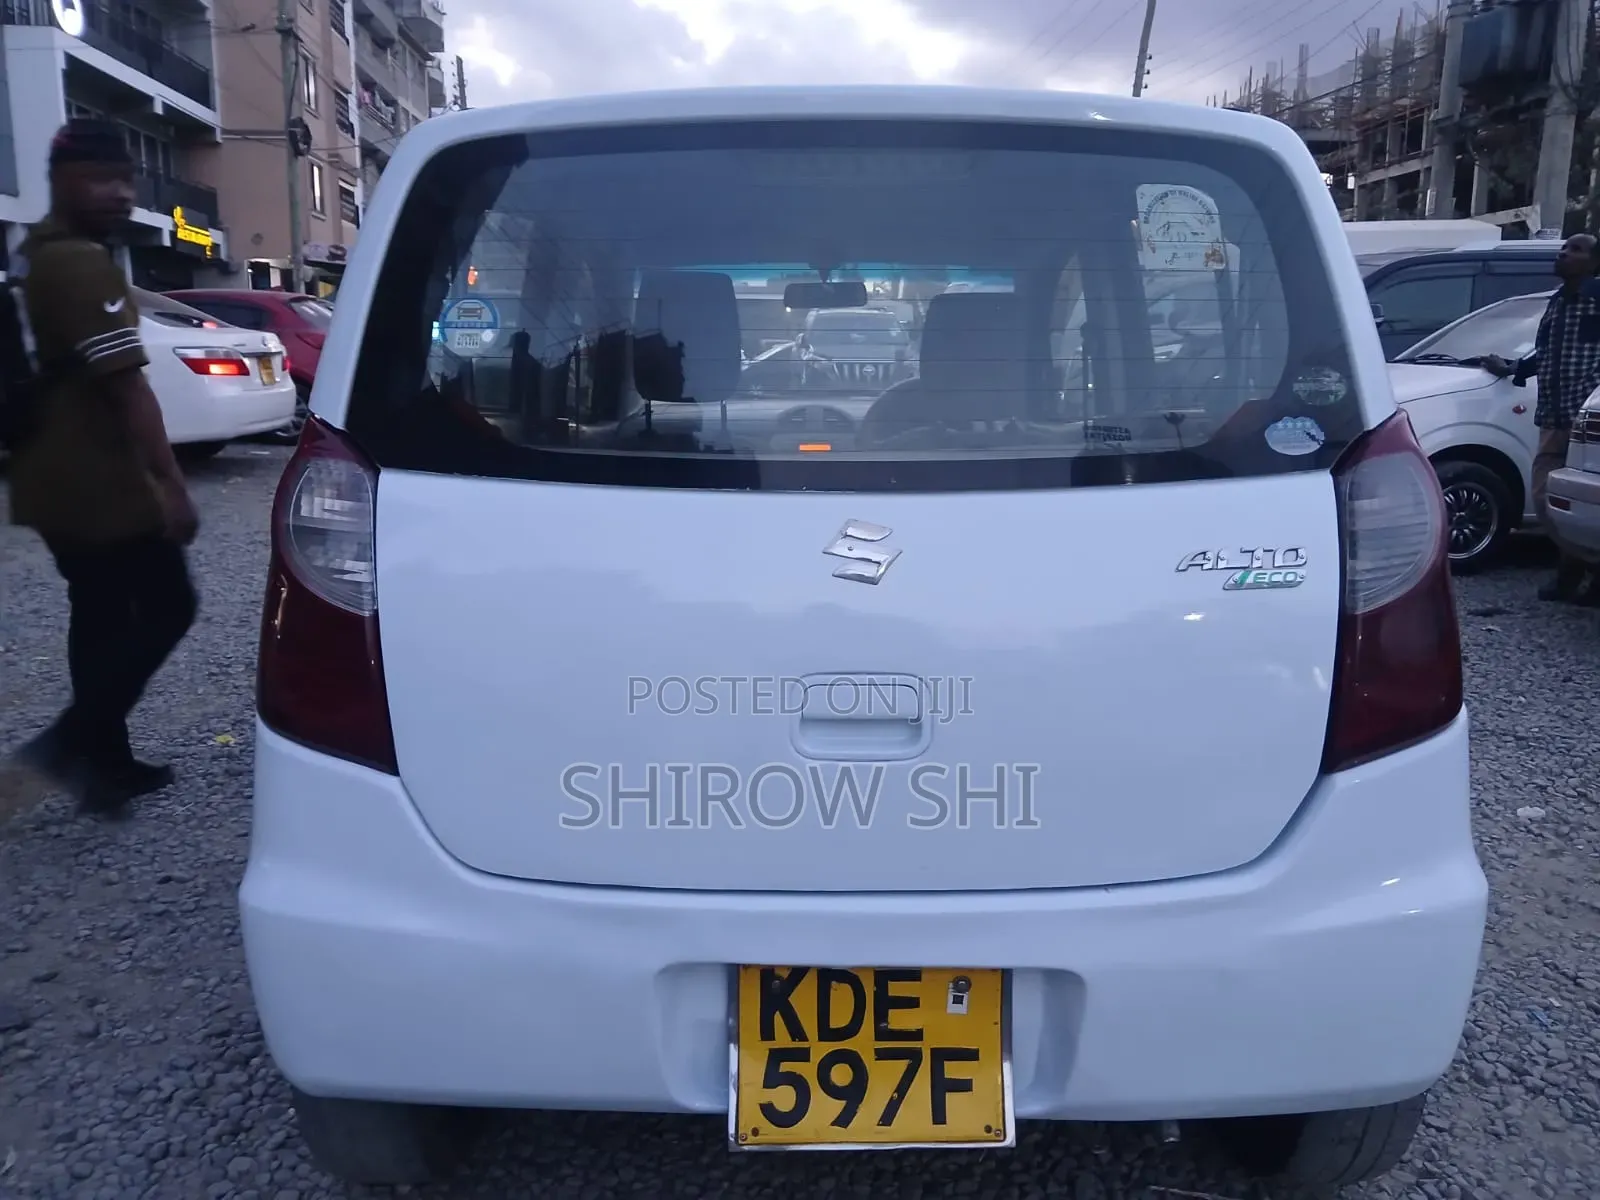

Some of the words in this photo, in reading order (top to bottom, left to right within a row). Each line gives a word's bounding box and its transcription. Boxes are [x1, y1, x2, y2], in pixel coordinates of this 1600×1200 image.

[1175, 547, 1308, 572] ALTO
[1252, 571, 1299, 585] ECO
[759, 967, 924, 1042] KDE
[758, 1046, 981, 1129] 597F
